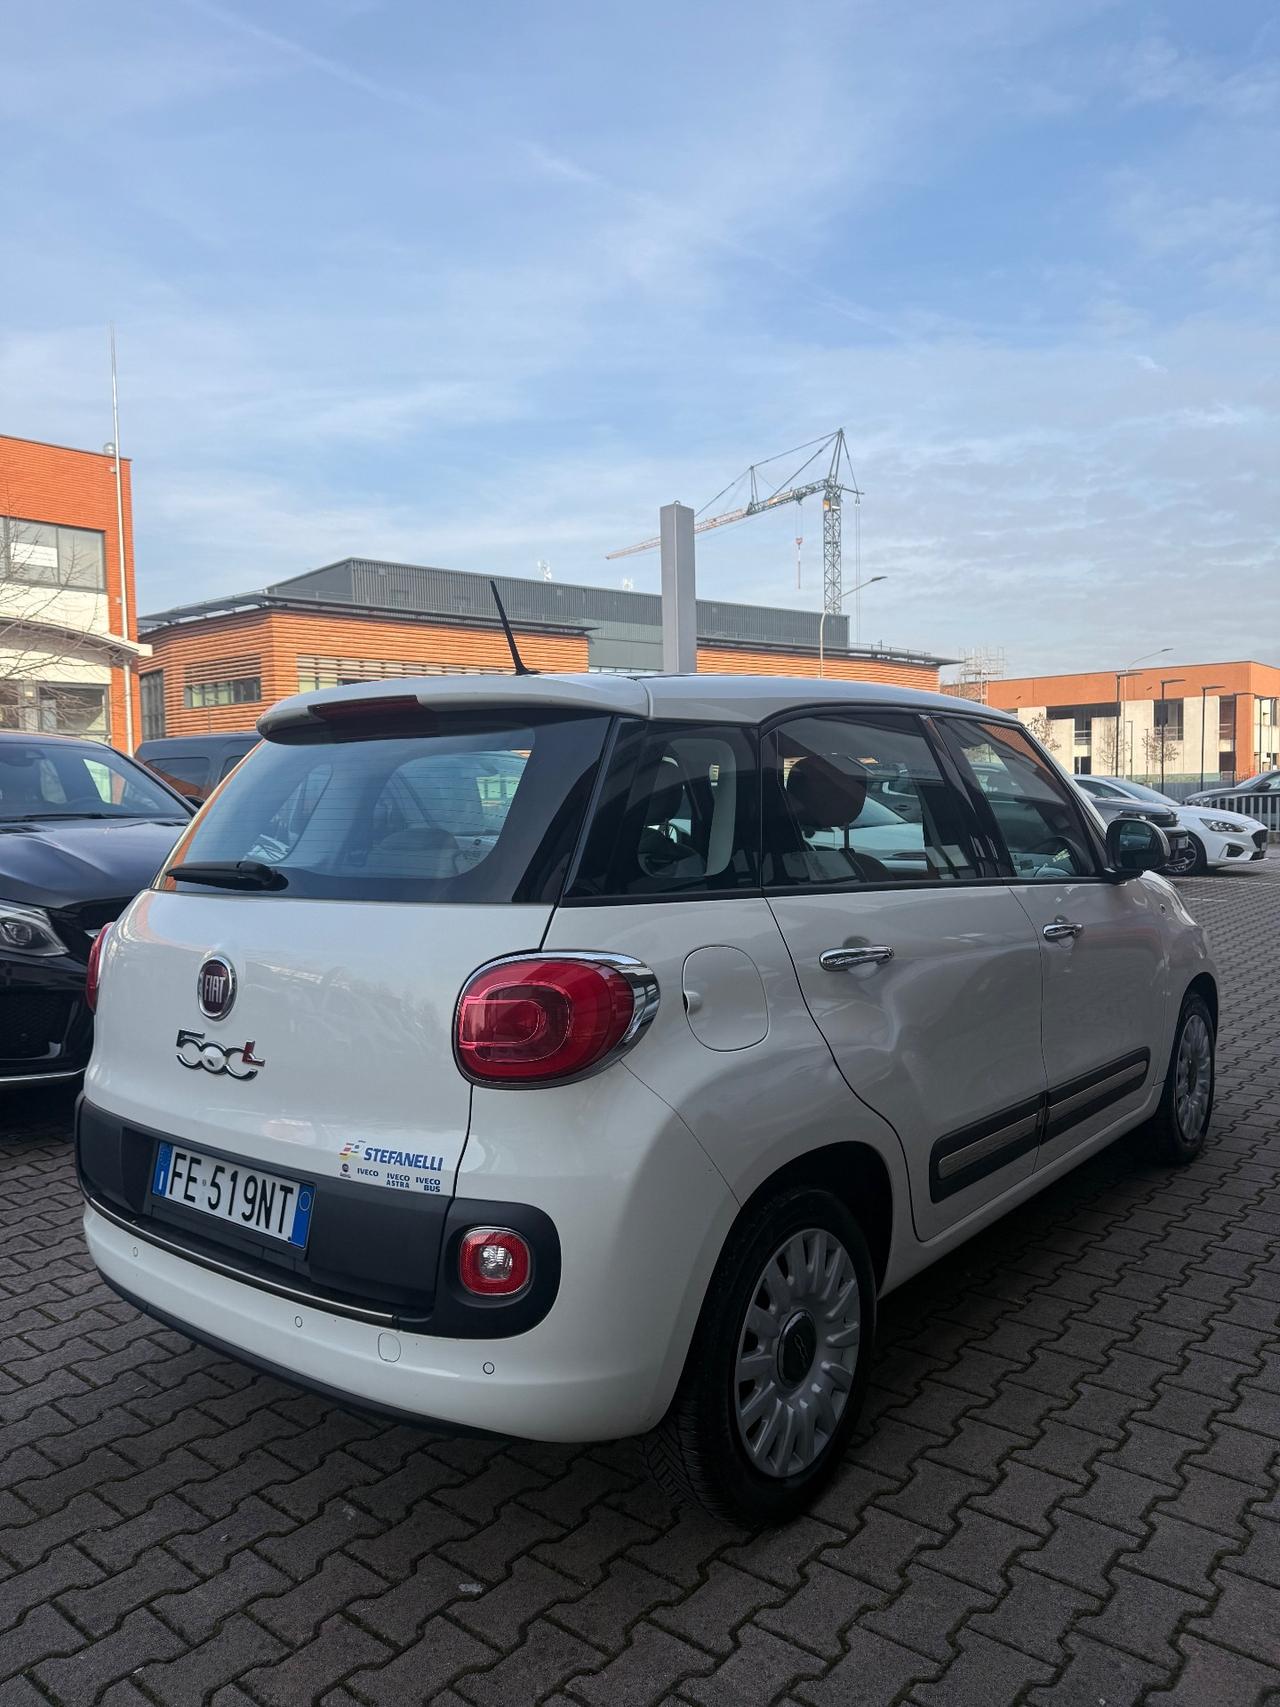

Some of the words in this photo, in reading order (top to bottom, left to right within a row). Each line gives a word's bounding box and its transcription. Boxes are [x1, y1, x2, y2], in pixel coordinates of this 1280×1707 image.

[204, 975, 226, 1004] FIAT
[363, 1147, 443, 1171] STEFANELLI
[357, 1168, 379, 1177] IVECO
[387, 1172, 410, 1181] IVECO
[386, 1180, 409, 1188] ASTRA
[415, 1176, 440, 1185] IVECO
